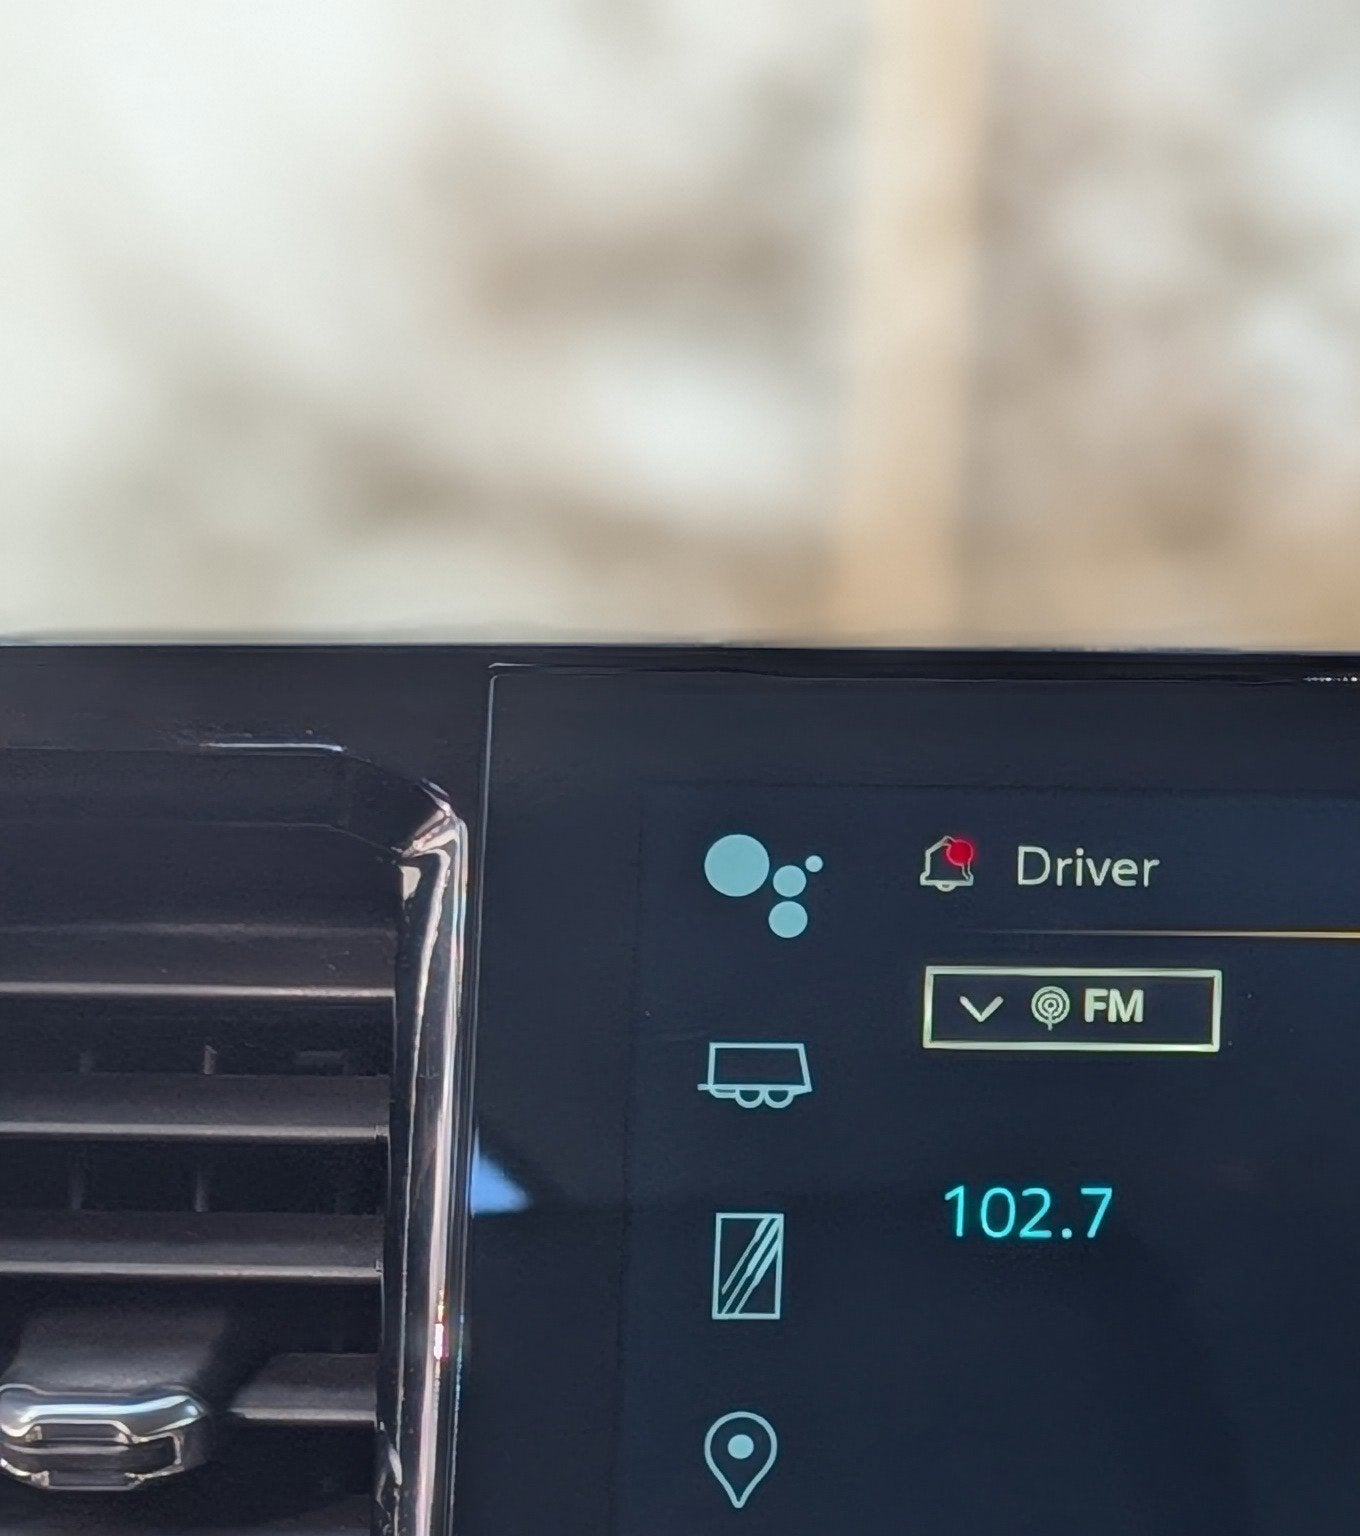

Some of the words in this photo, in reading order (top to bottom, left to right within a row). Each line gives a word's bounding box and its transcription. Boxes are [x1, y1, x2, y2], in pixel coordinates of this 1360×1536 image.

[1017, 846, 1160, 887] Driver
[1084, 988, 1144, 1023] FM
[944, 1185, 1113, 1240] 102.7
